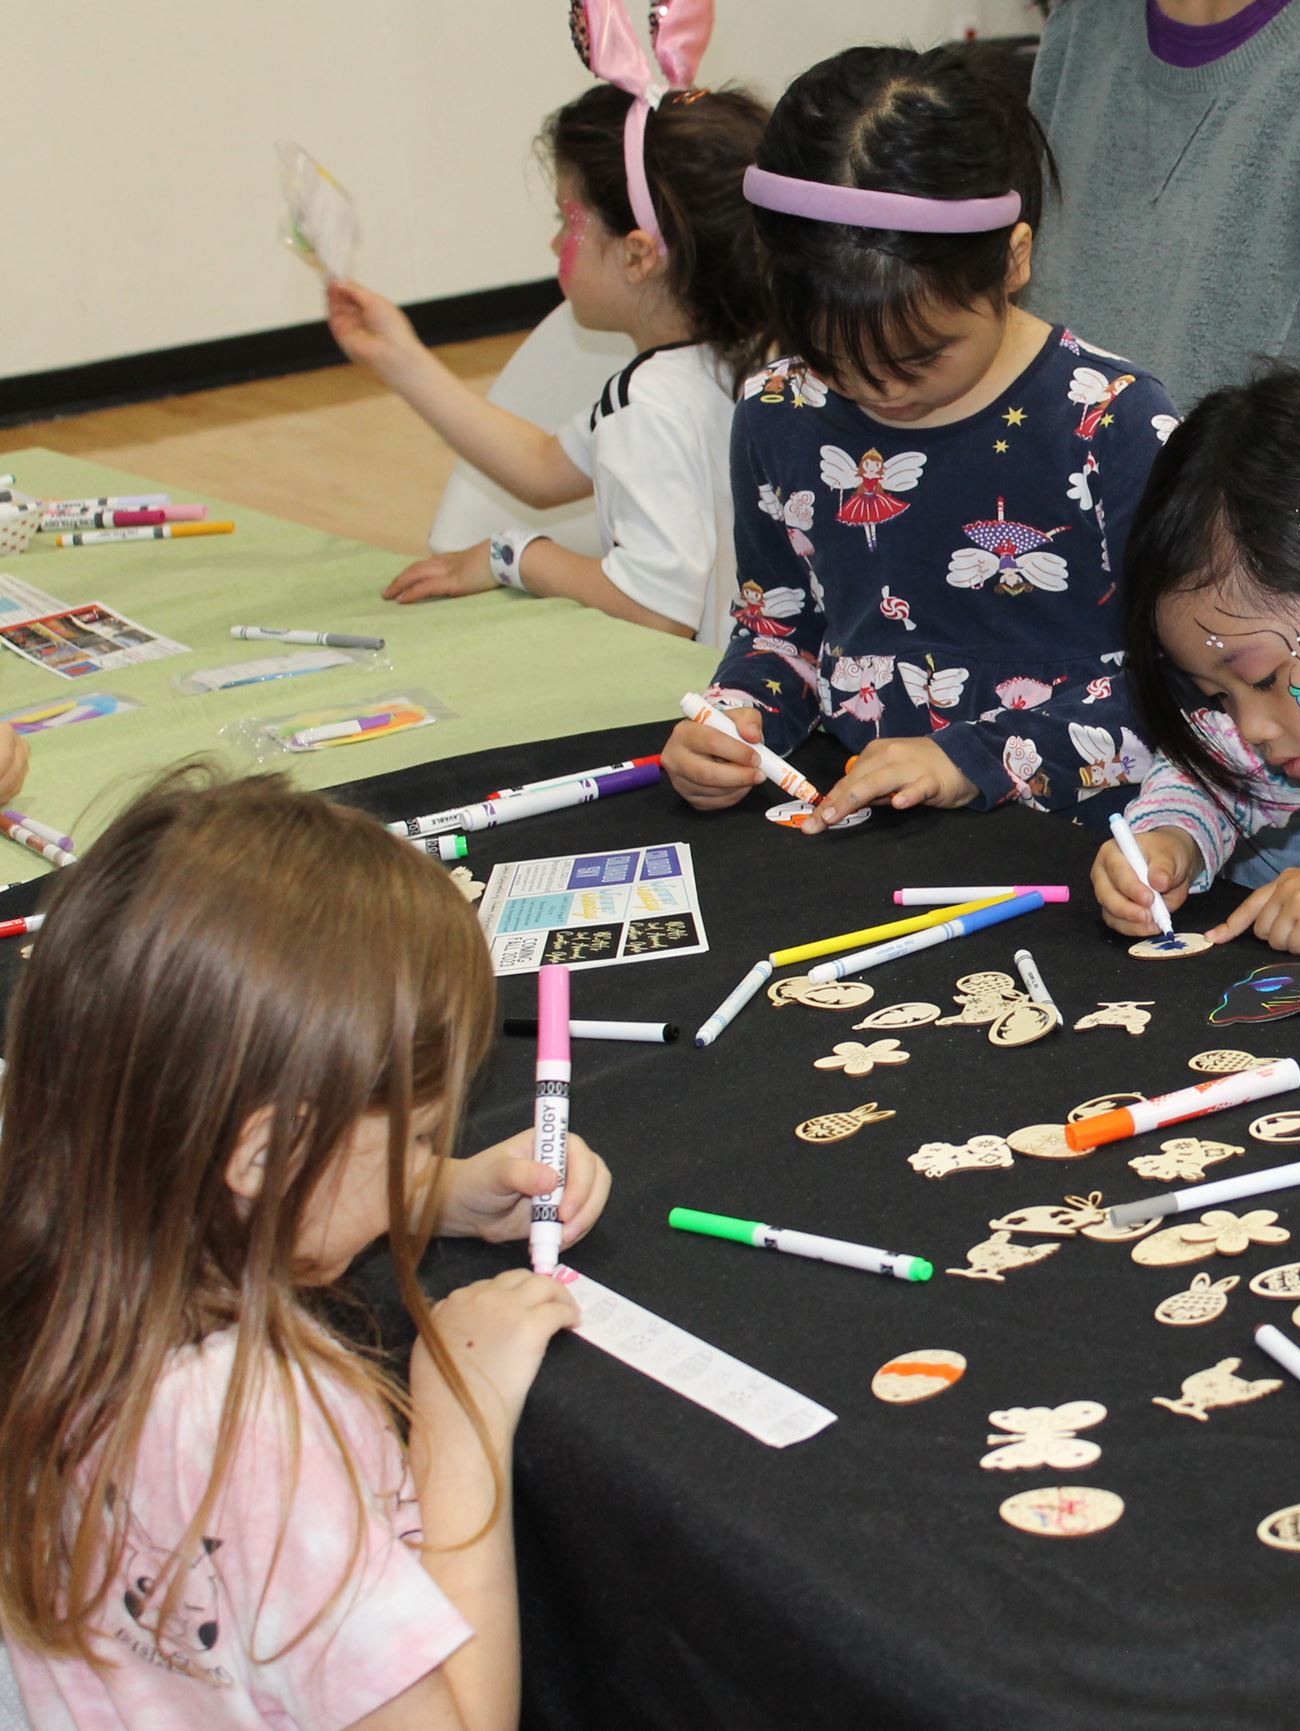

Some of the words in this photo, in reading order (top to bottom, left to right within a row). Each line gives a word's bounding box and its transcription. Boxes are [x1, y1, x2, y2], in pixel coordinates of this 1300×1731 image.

[431, 814, 461, 825] AVABLE
[504, 937, 523, 952] FALL
[517, 937, 539, 963] COMING
[500, 952, 518, 967] 2023
[540, 1104, 557, 1203] CTOLOGY
